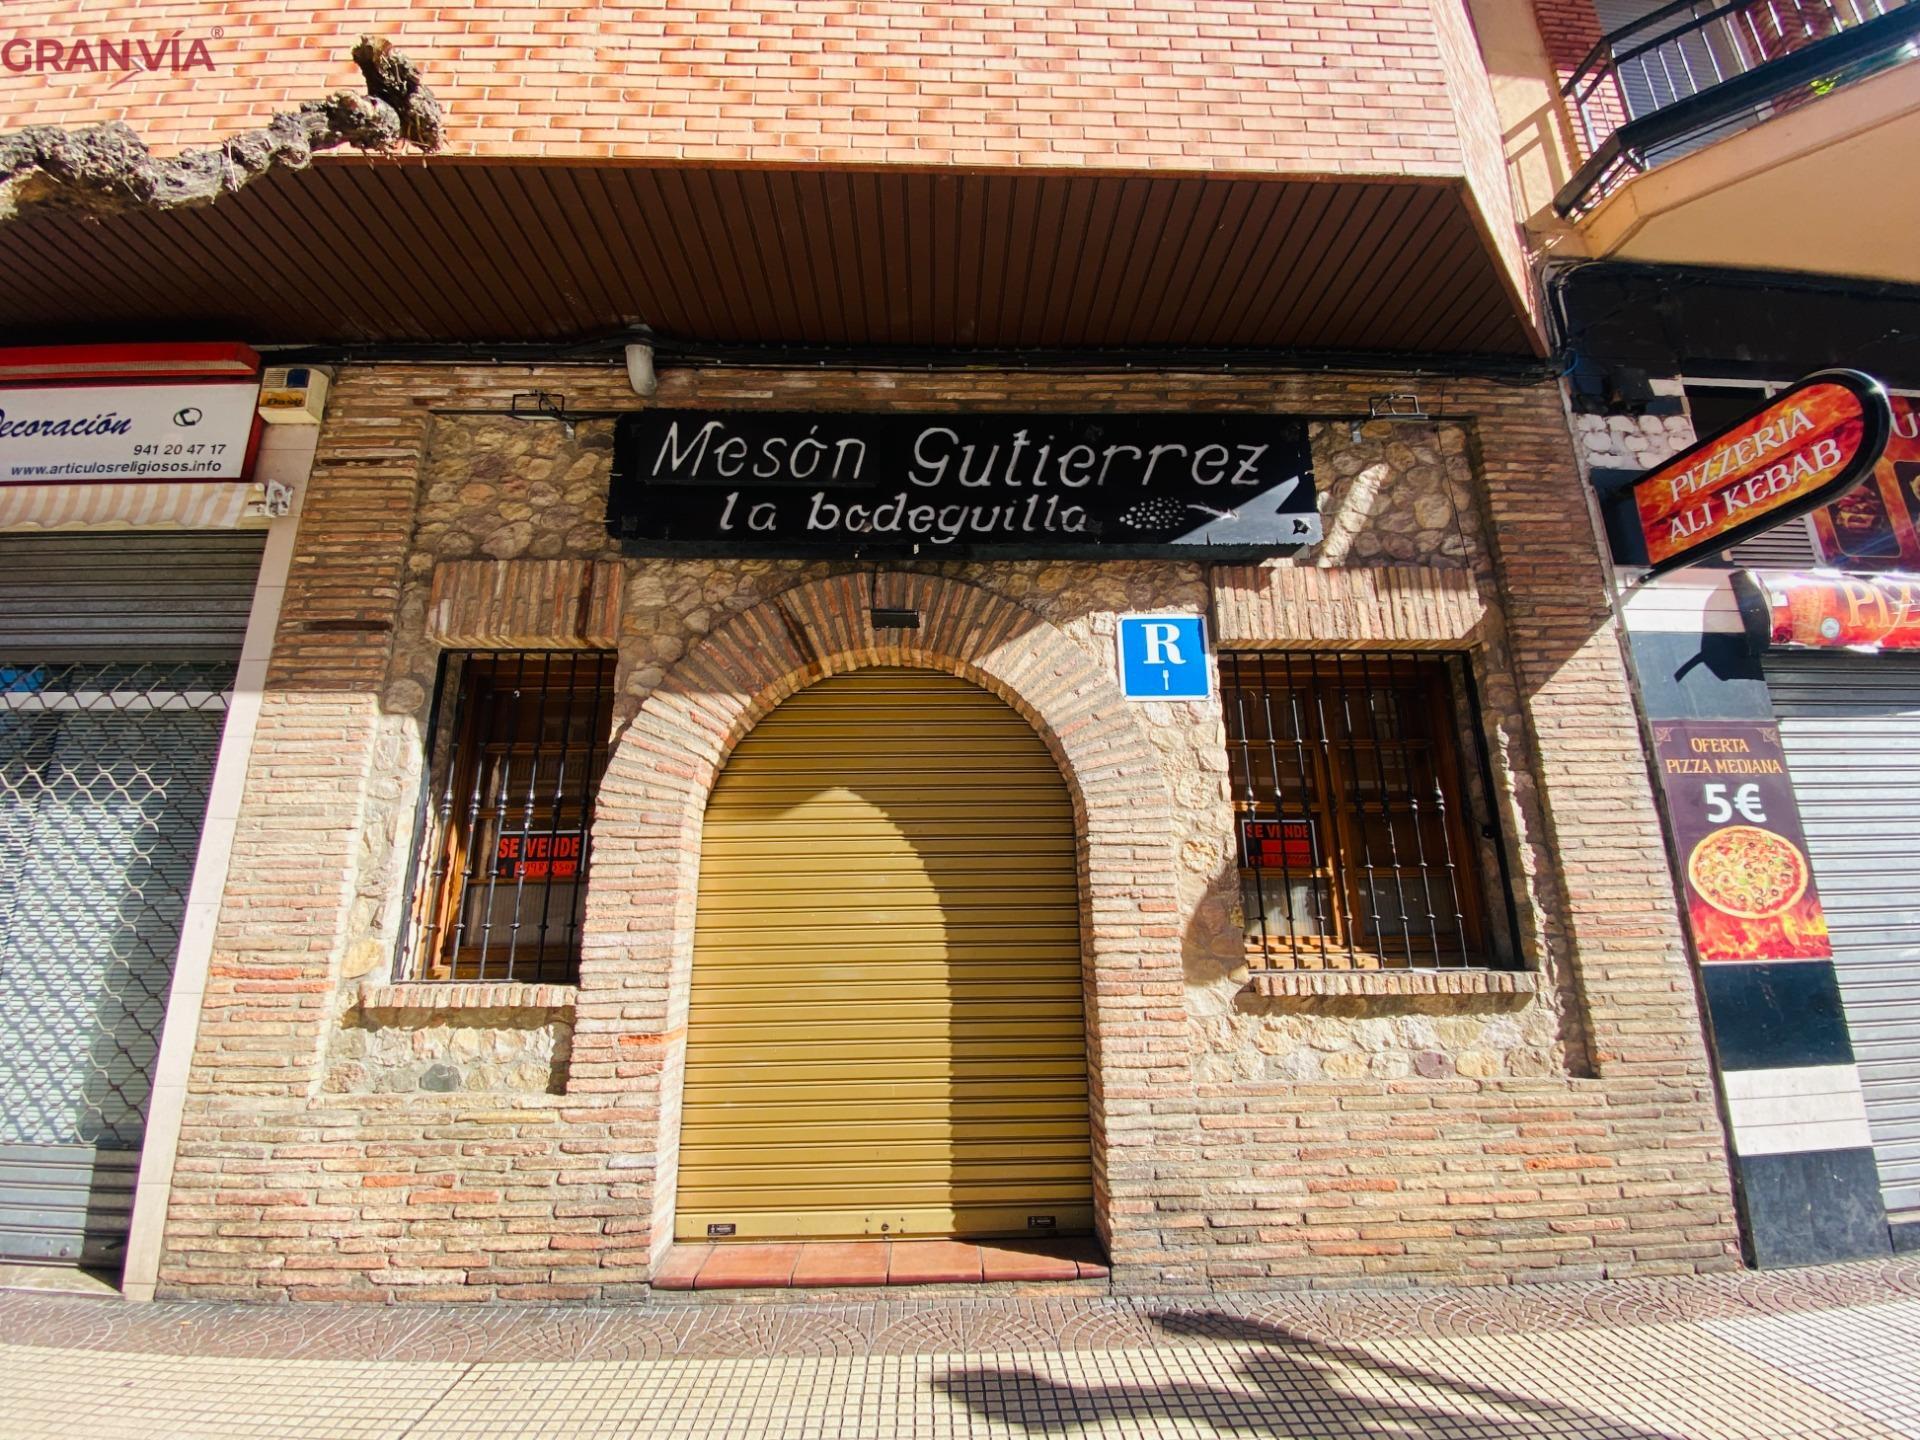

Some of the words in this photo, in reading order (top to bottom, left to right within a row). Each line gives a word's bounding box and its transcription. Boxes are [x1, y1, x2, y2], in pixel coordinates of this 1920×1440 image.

[0, 408, 132, 438] ecoración
[133, 444, 158, 456] 941
[164, 444, 182, 455] 20
[187, 444, 205, 455] 47
[210, 444, 226, 455] 17
[652, 421, 866, 479] Mesón
[908, 426, 1269, 488] Gutierrez
[1670, 408, 1815, 502] PIZZERIA
[10, 460, 222, 476] www.articulosreligiosos.info
[1670, 503, 1714, 543] ALI
[1722, 438, 1842, 516] KEBAB
[719, 491, 777, 530] la
[806, 492, 1087, 544] bodeguilla
[1142, 624, 1187, 666] R
[1690, 738, 1750, 753] OFERTA
[1665, 759, 1713, 774] PIZZA
[1715, 758, 1784, 774] MEDIANA
[1704, 783, 1767, 823] 5€
[498, 837, 519, 858] SE
